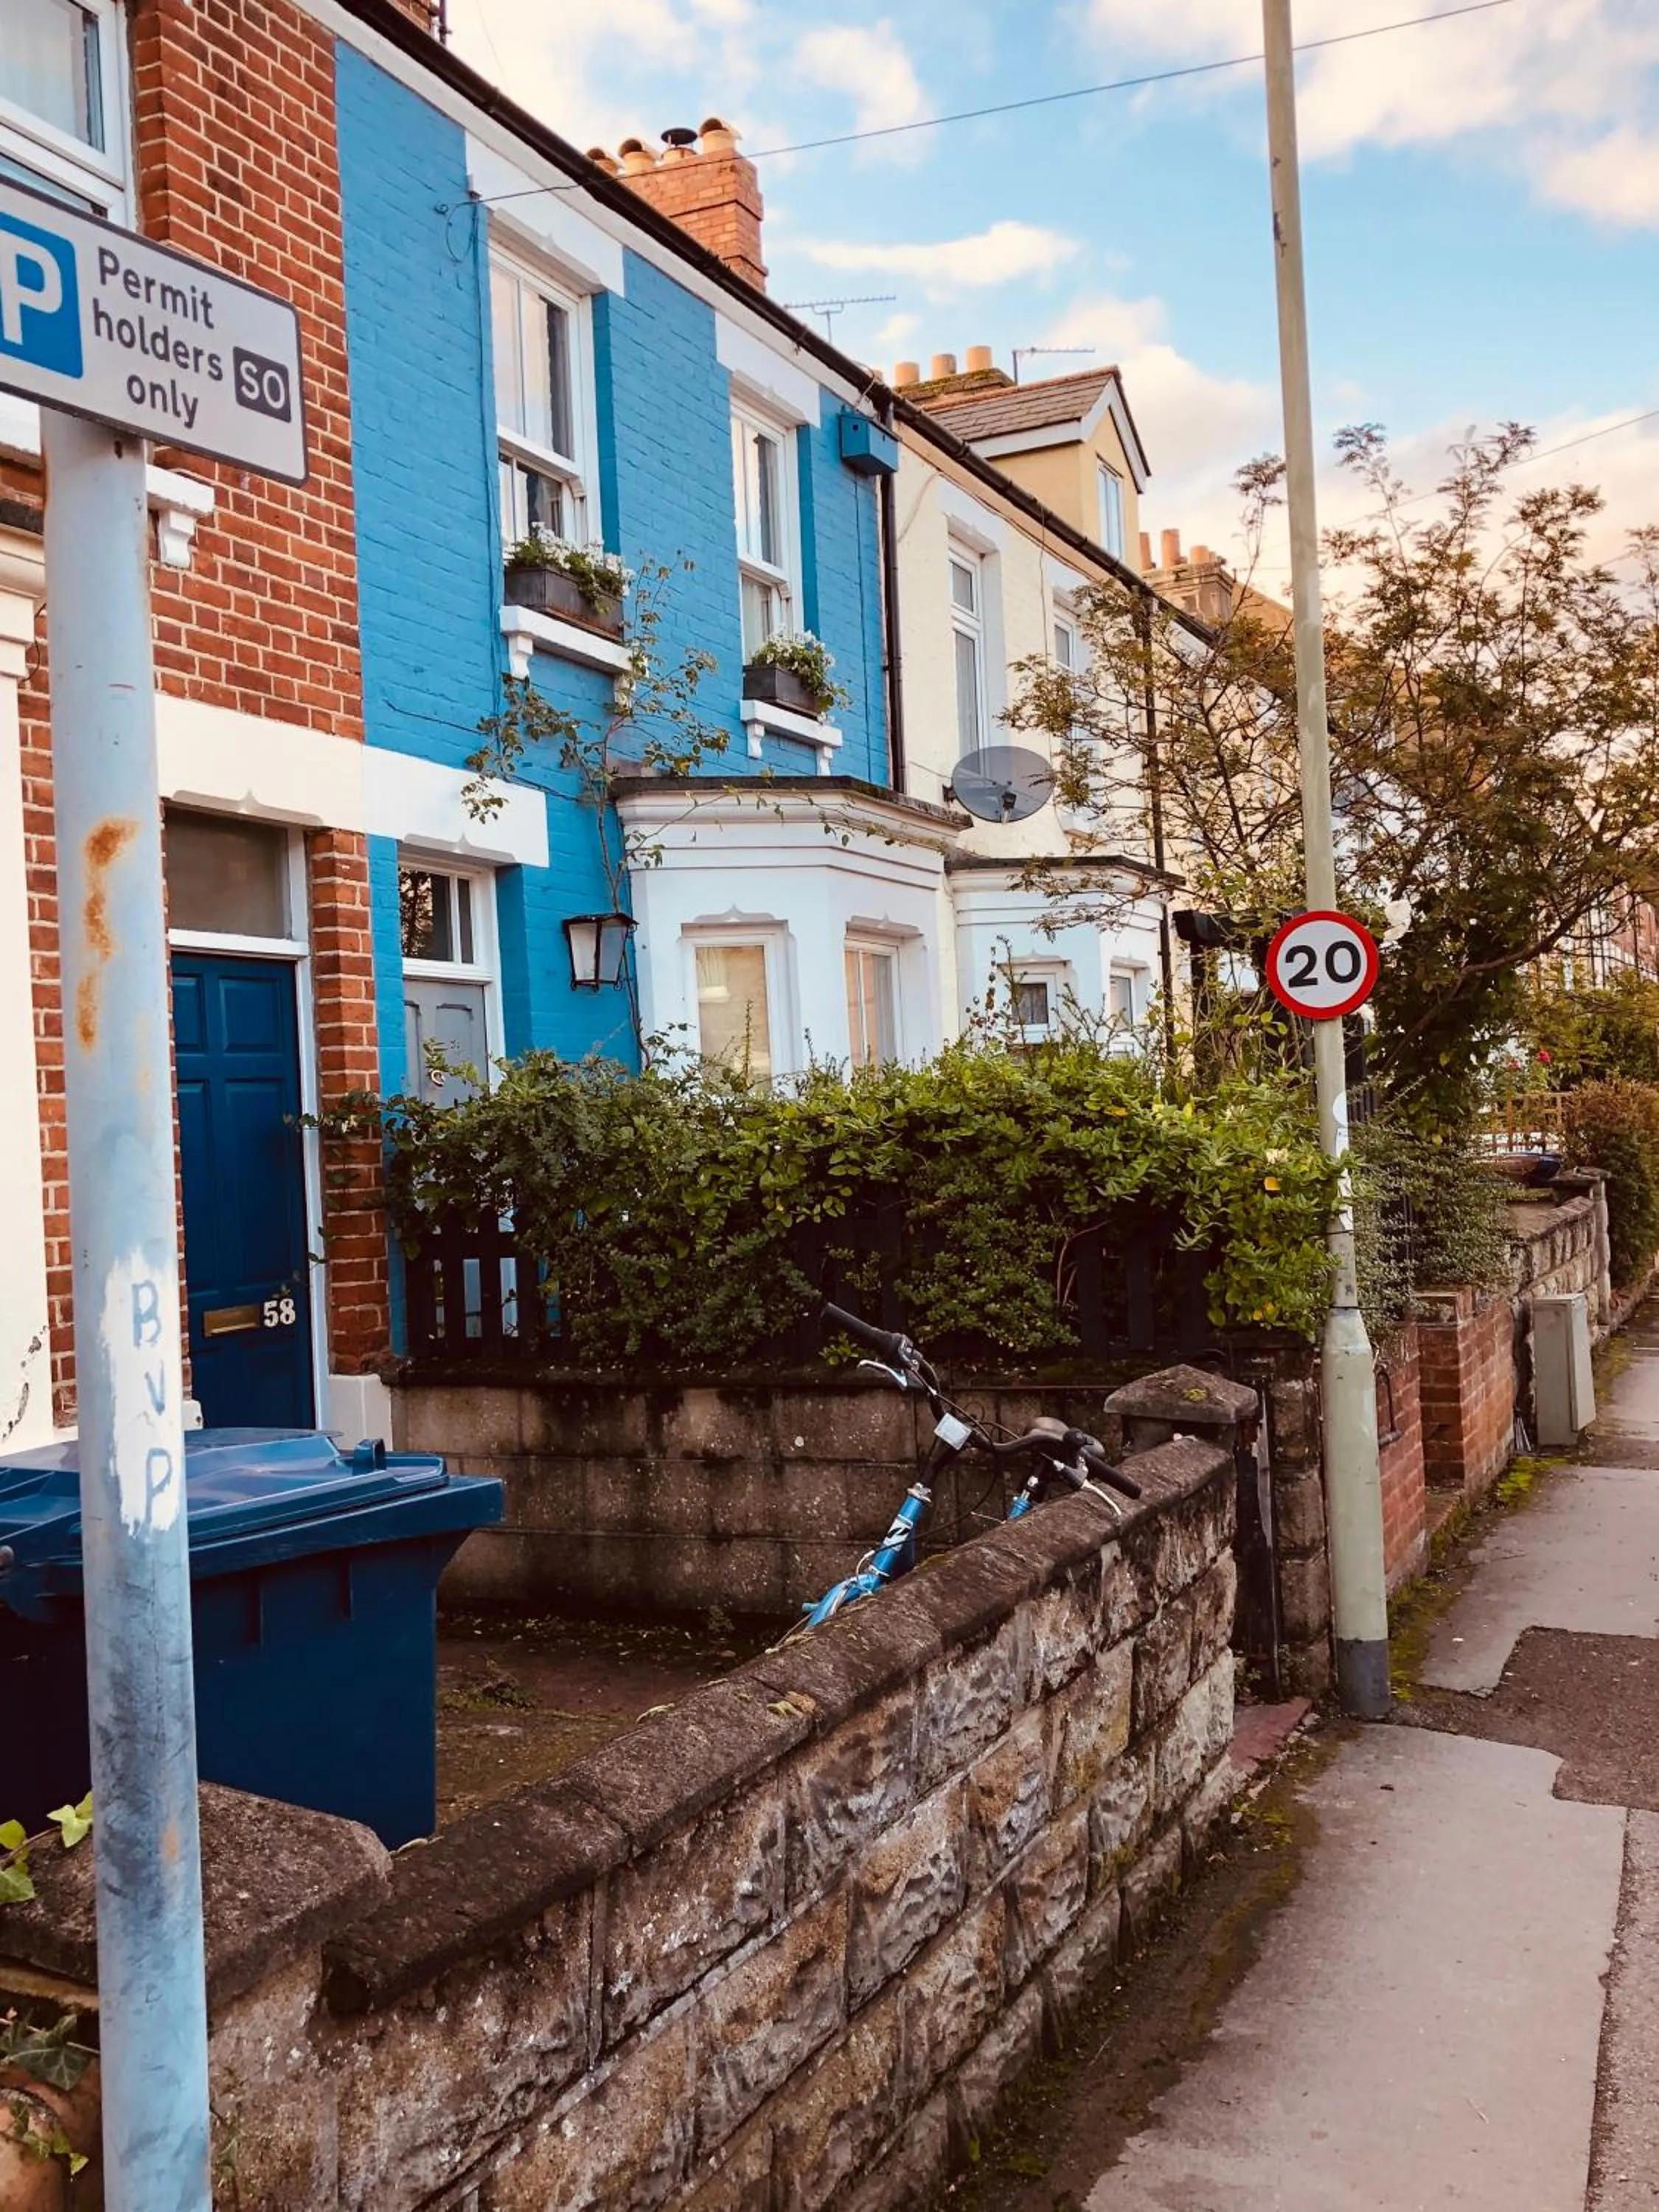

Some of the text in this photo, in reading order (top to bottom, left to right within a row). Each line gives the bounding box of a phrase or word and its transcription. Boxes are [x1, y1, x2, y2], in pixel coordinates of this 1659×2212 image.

[0, 227, 63, 345] P
[98, 246, 214, 330] Permit
[93, 297, 286, 410] holders SO
[127, 374, 199, 429] only
[1284, 940, 1361, 988] 20
[263, 1298, 296, 1327] 58
